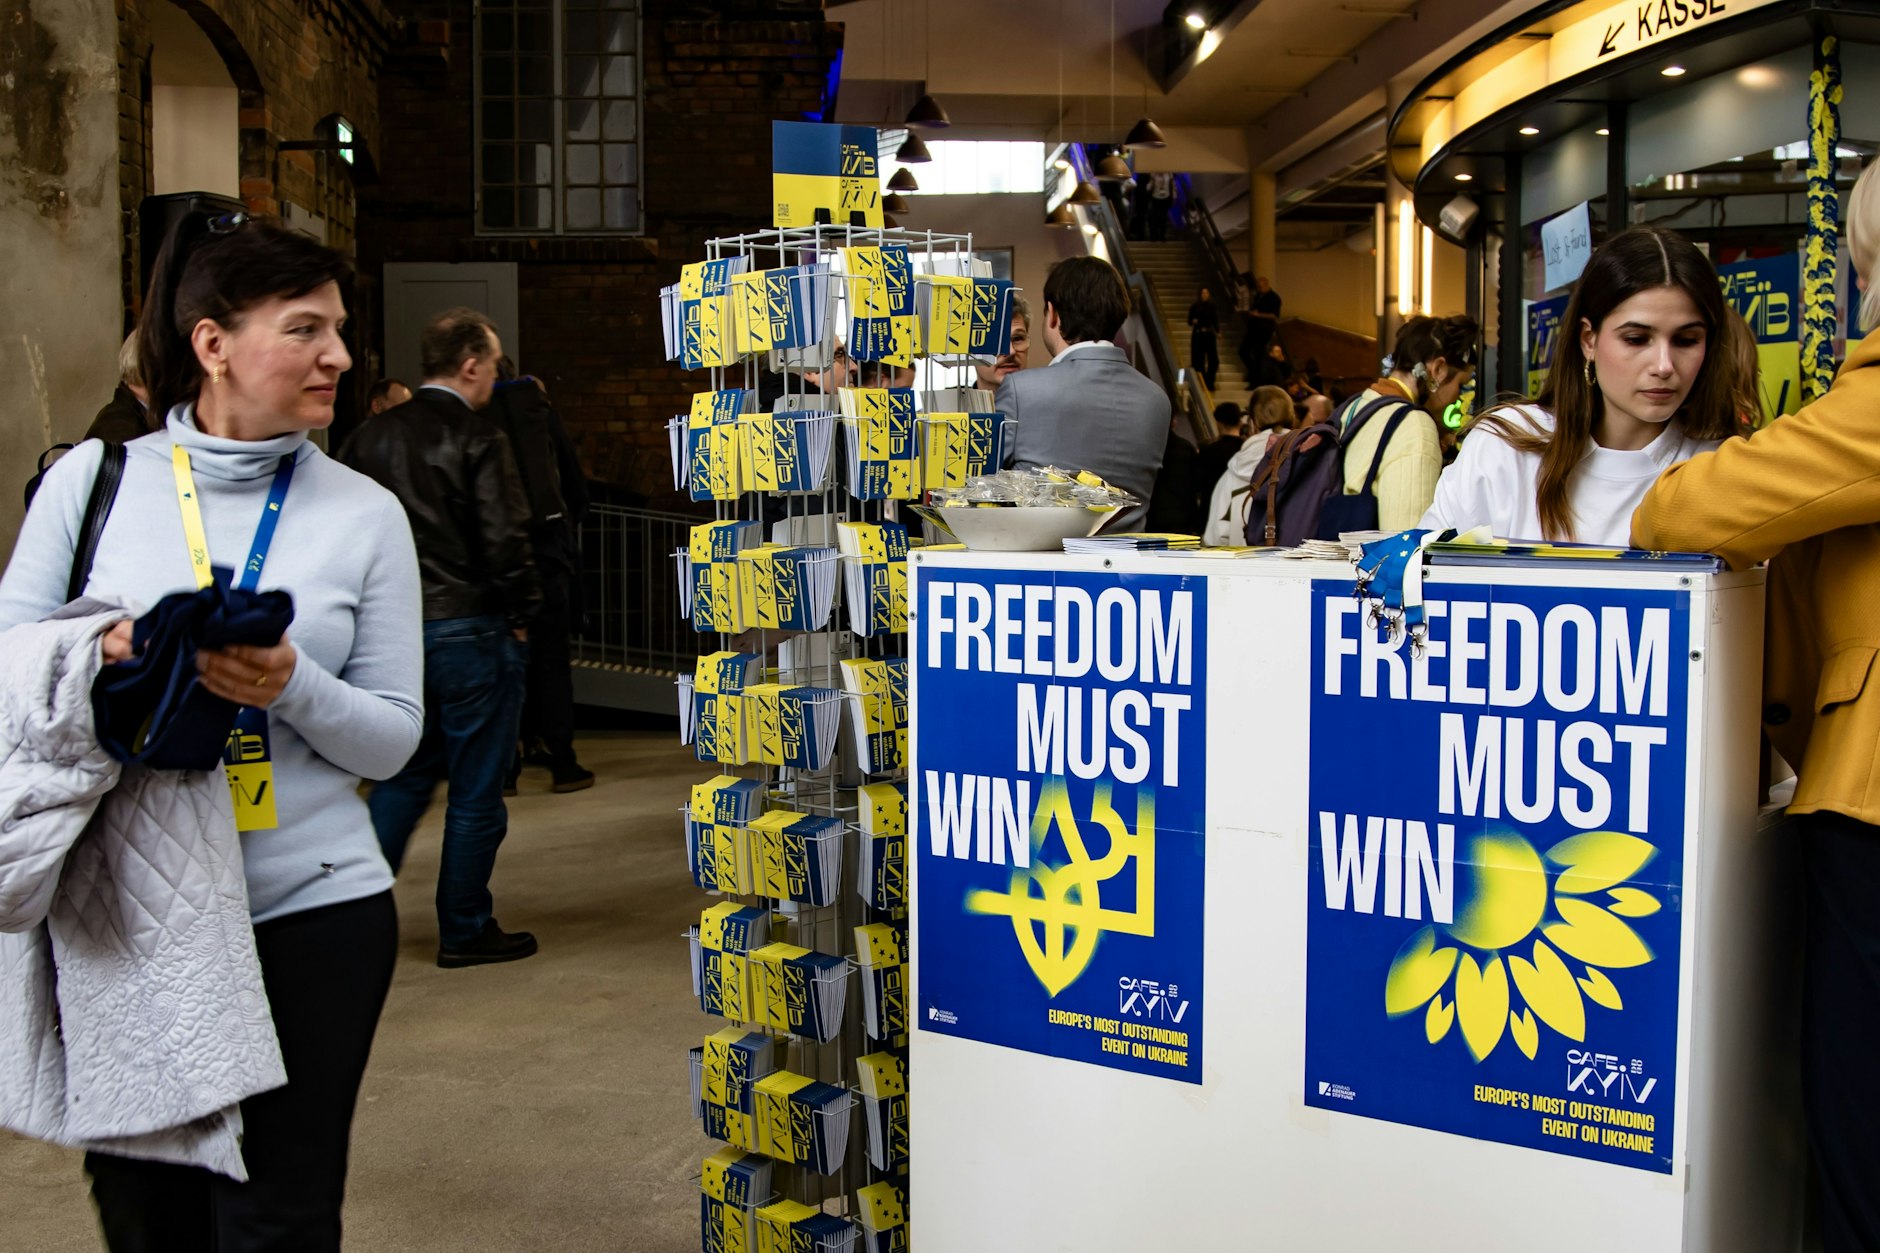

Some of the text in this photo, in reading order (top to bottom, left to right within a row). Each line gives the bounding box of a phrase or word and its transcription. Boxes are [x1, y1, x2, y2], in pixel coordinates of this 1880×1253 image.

[928, 581, 1193, 685] FREEDOM
[1324, 596, 1670, 716] FREEDOM
[1017, 682, 1191, 787] MUST
[1439, 712, 1667, 833] MUST
[925, 769, 1030, 868] WIN
[1319, 811, 1454, 924] WIN
[1119, 976, 1159, 994] CAFE
[1049, 1009, 1188, 1048] EUROPE'S MOST OUTSTANDING
[1102, 1037, 1188, 1067] EVENT ON UKRAINE
[1567, 1049, 1618, 1070] CAFE
[1474, 1085, 1655, 1132] EUROPE'S MOST OUTSTANDING
[1542, 1117, 1654, 1154] EVENT ON UKRAINE
